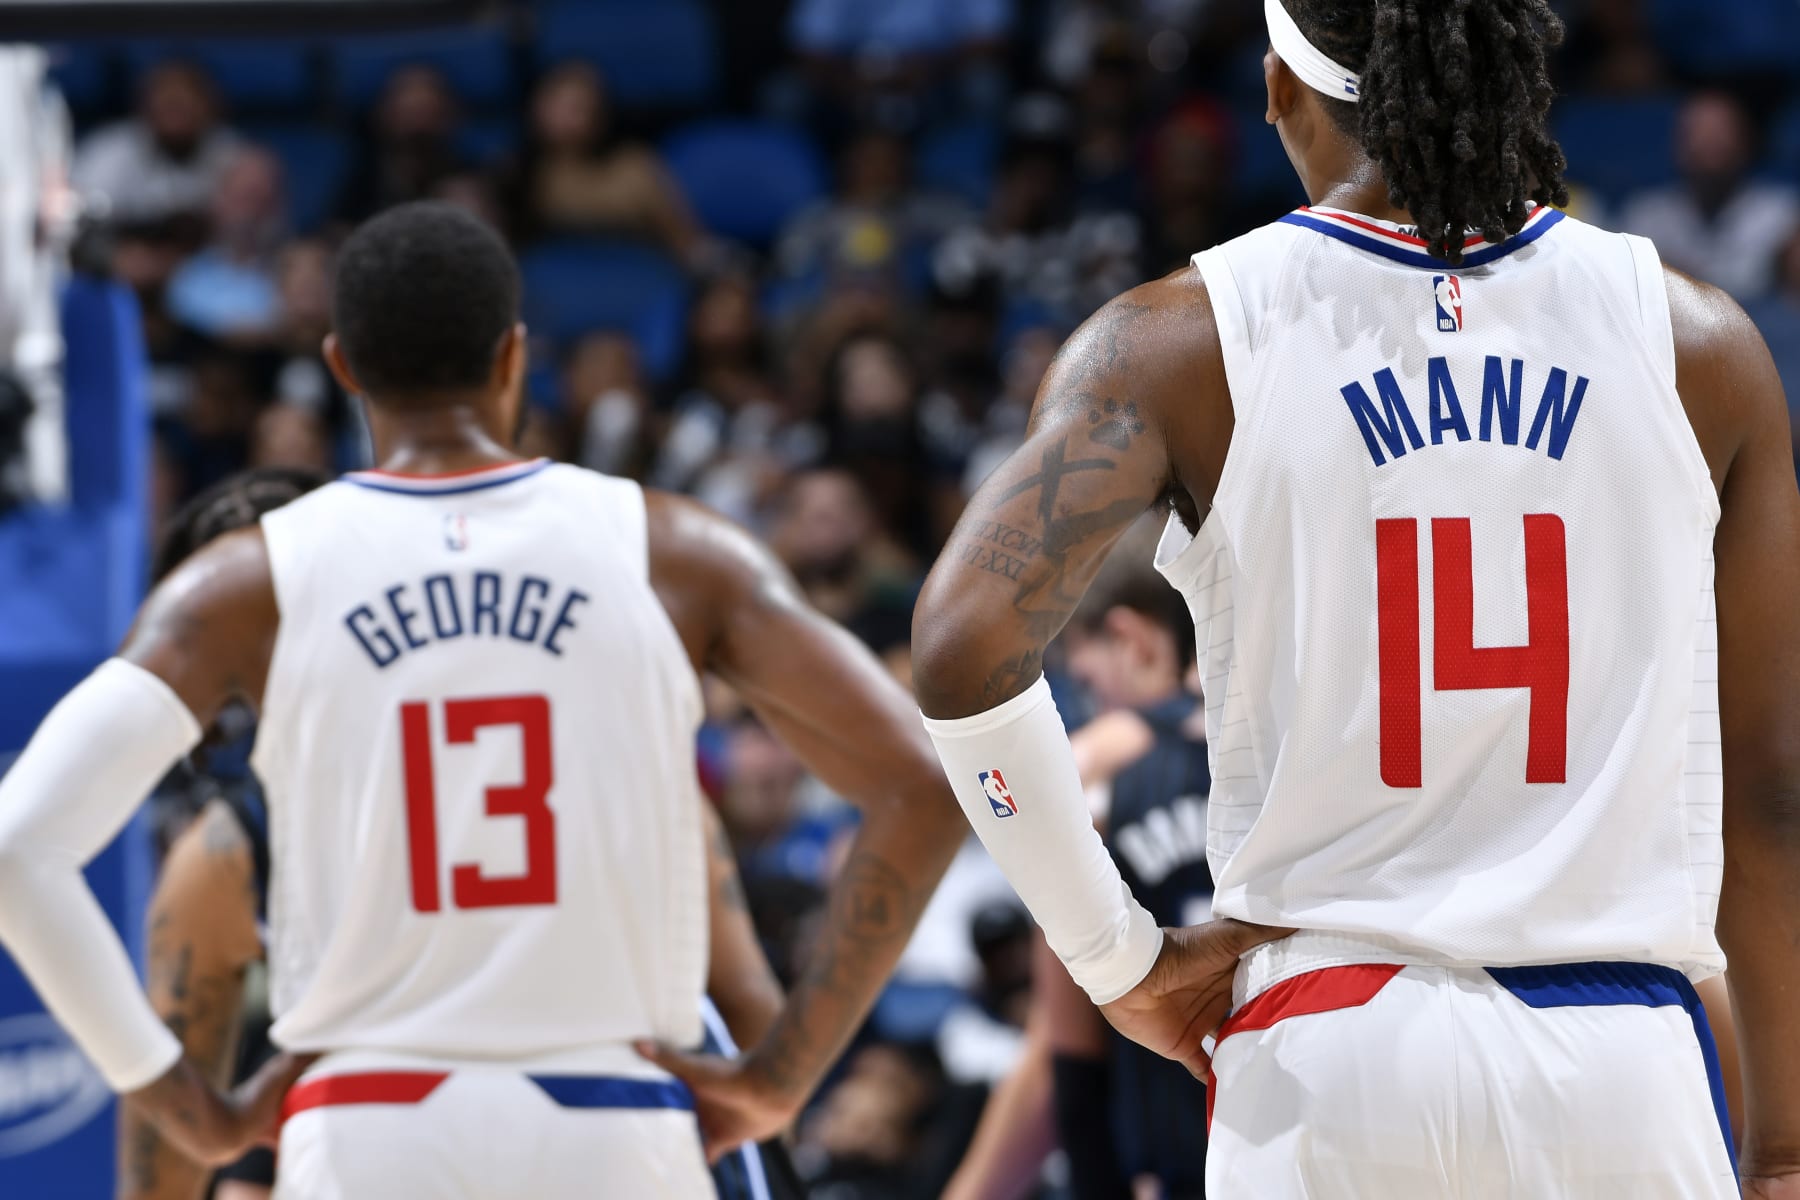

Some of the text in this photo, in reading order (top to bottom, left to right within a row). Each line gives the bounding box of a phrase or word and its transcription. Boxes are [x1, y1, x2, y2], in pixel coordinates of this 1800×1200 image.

[1440, 318, 1454, 329] NBA
[1340, 355, 1589, 467] MANN
[344, 570, 590, 669] GEORGE
[1376, 513, 1569, 788] 14
[400, 694, 558, 914] 13
